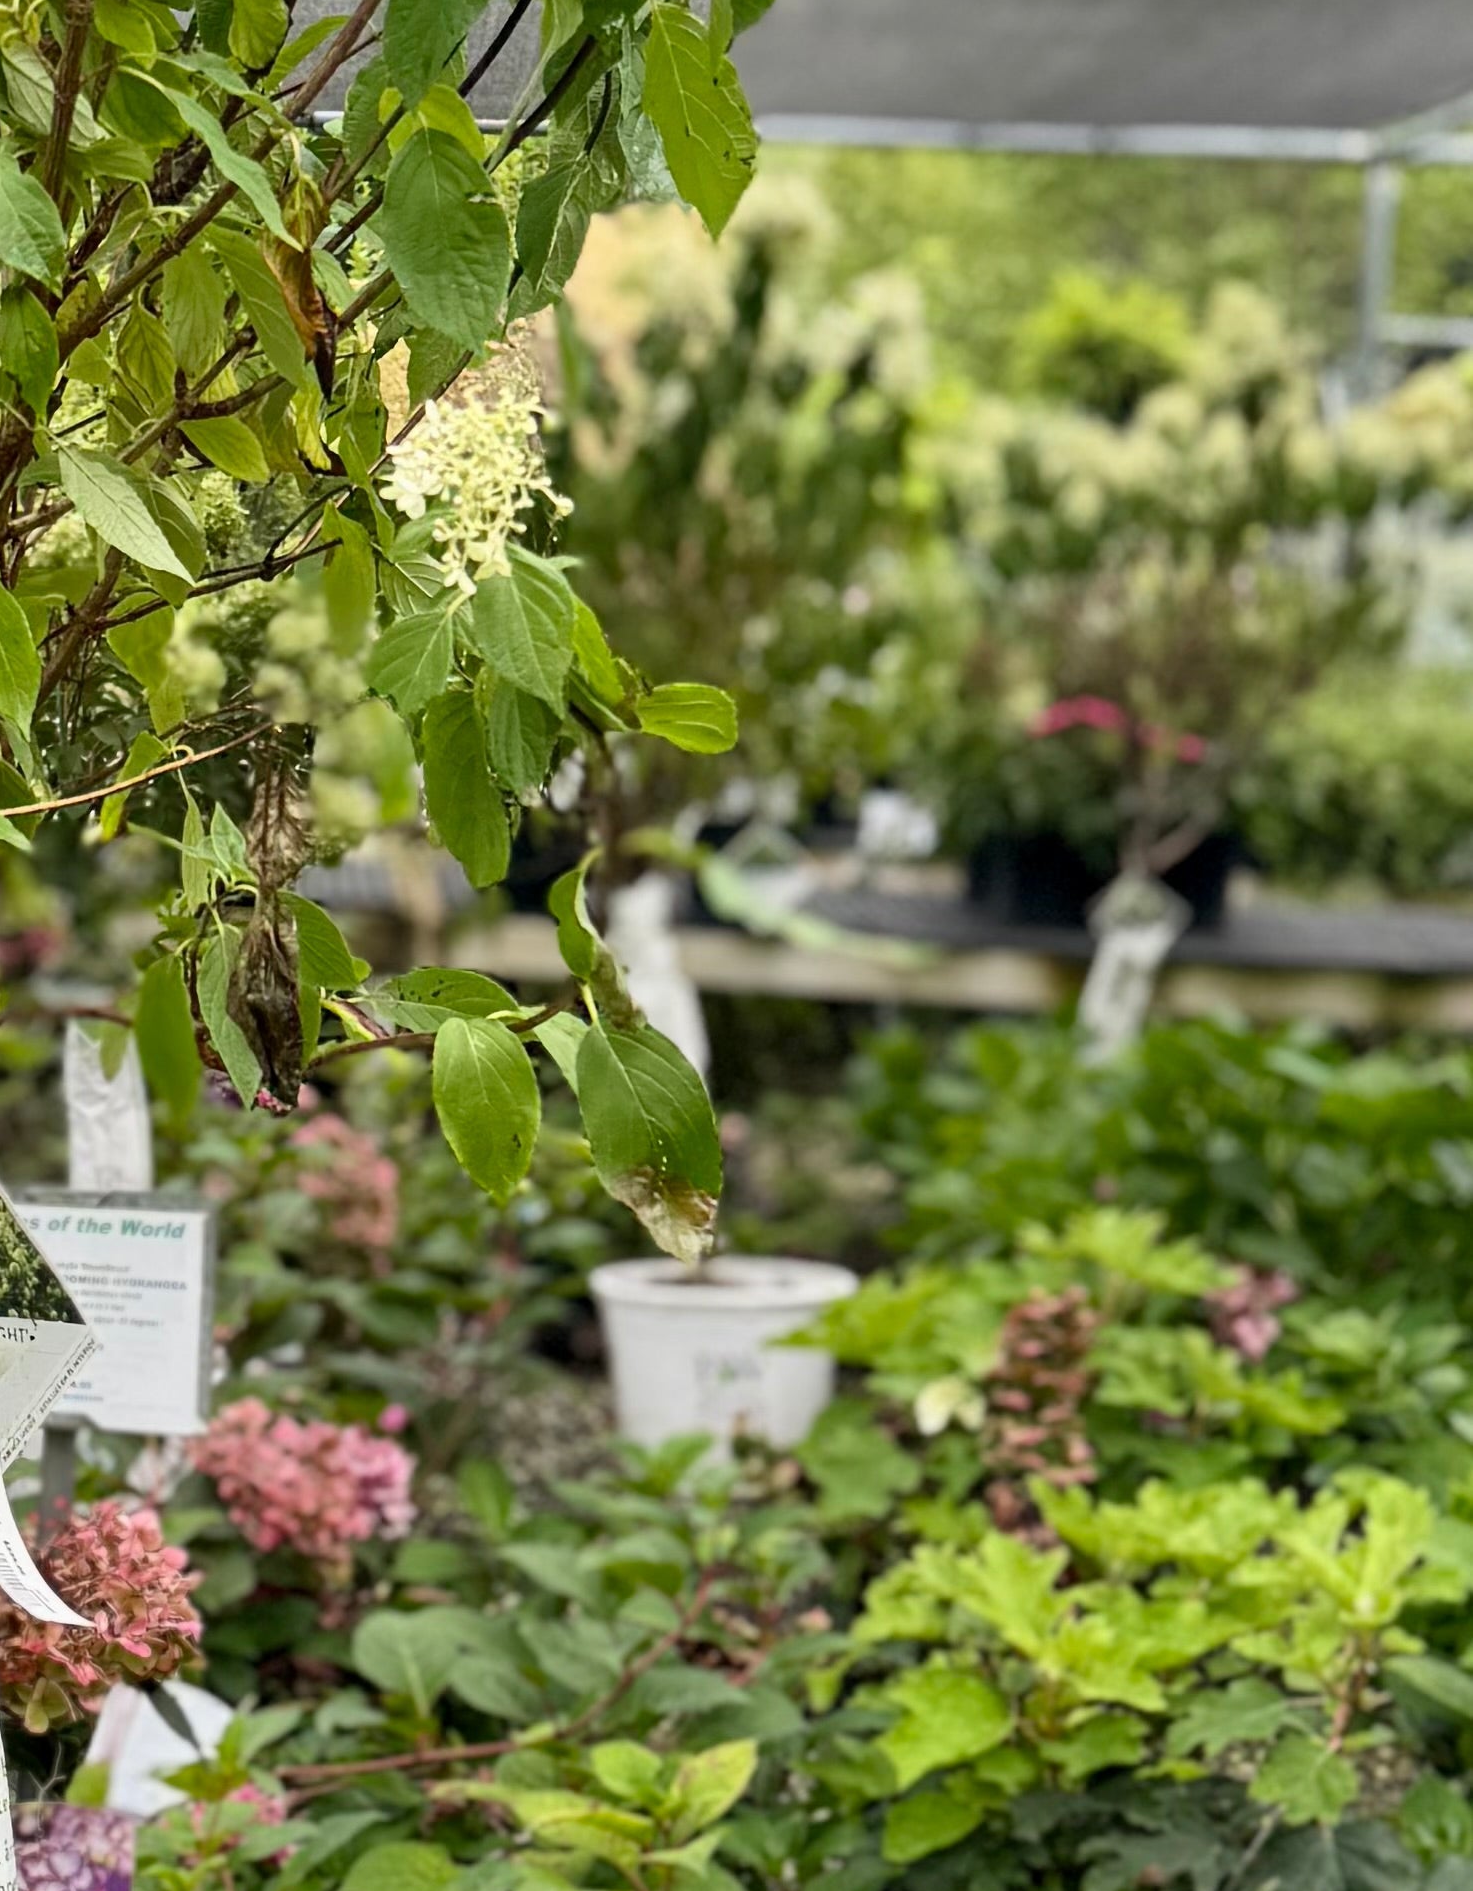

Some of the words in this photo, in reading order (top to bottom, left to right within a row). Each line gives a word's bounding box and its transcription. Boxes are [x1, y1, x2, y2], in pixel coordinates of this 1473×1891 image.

[47, 1216, 71, 1231] of
[77, 1217, 112, 1235] the
[120, 1219, 186, 1239] World
